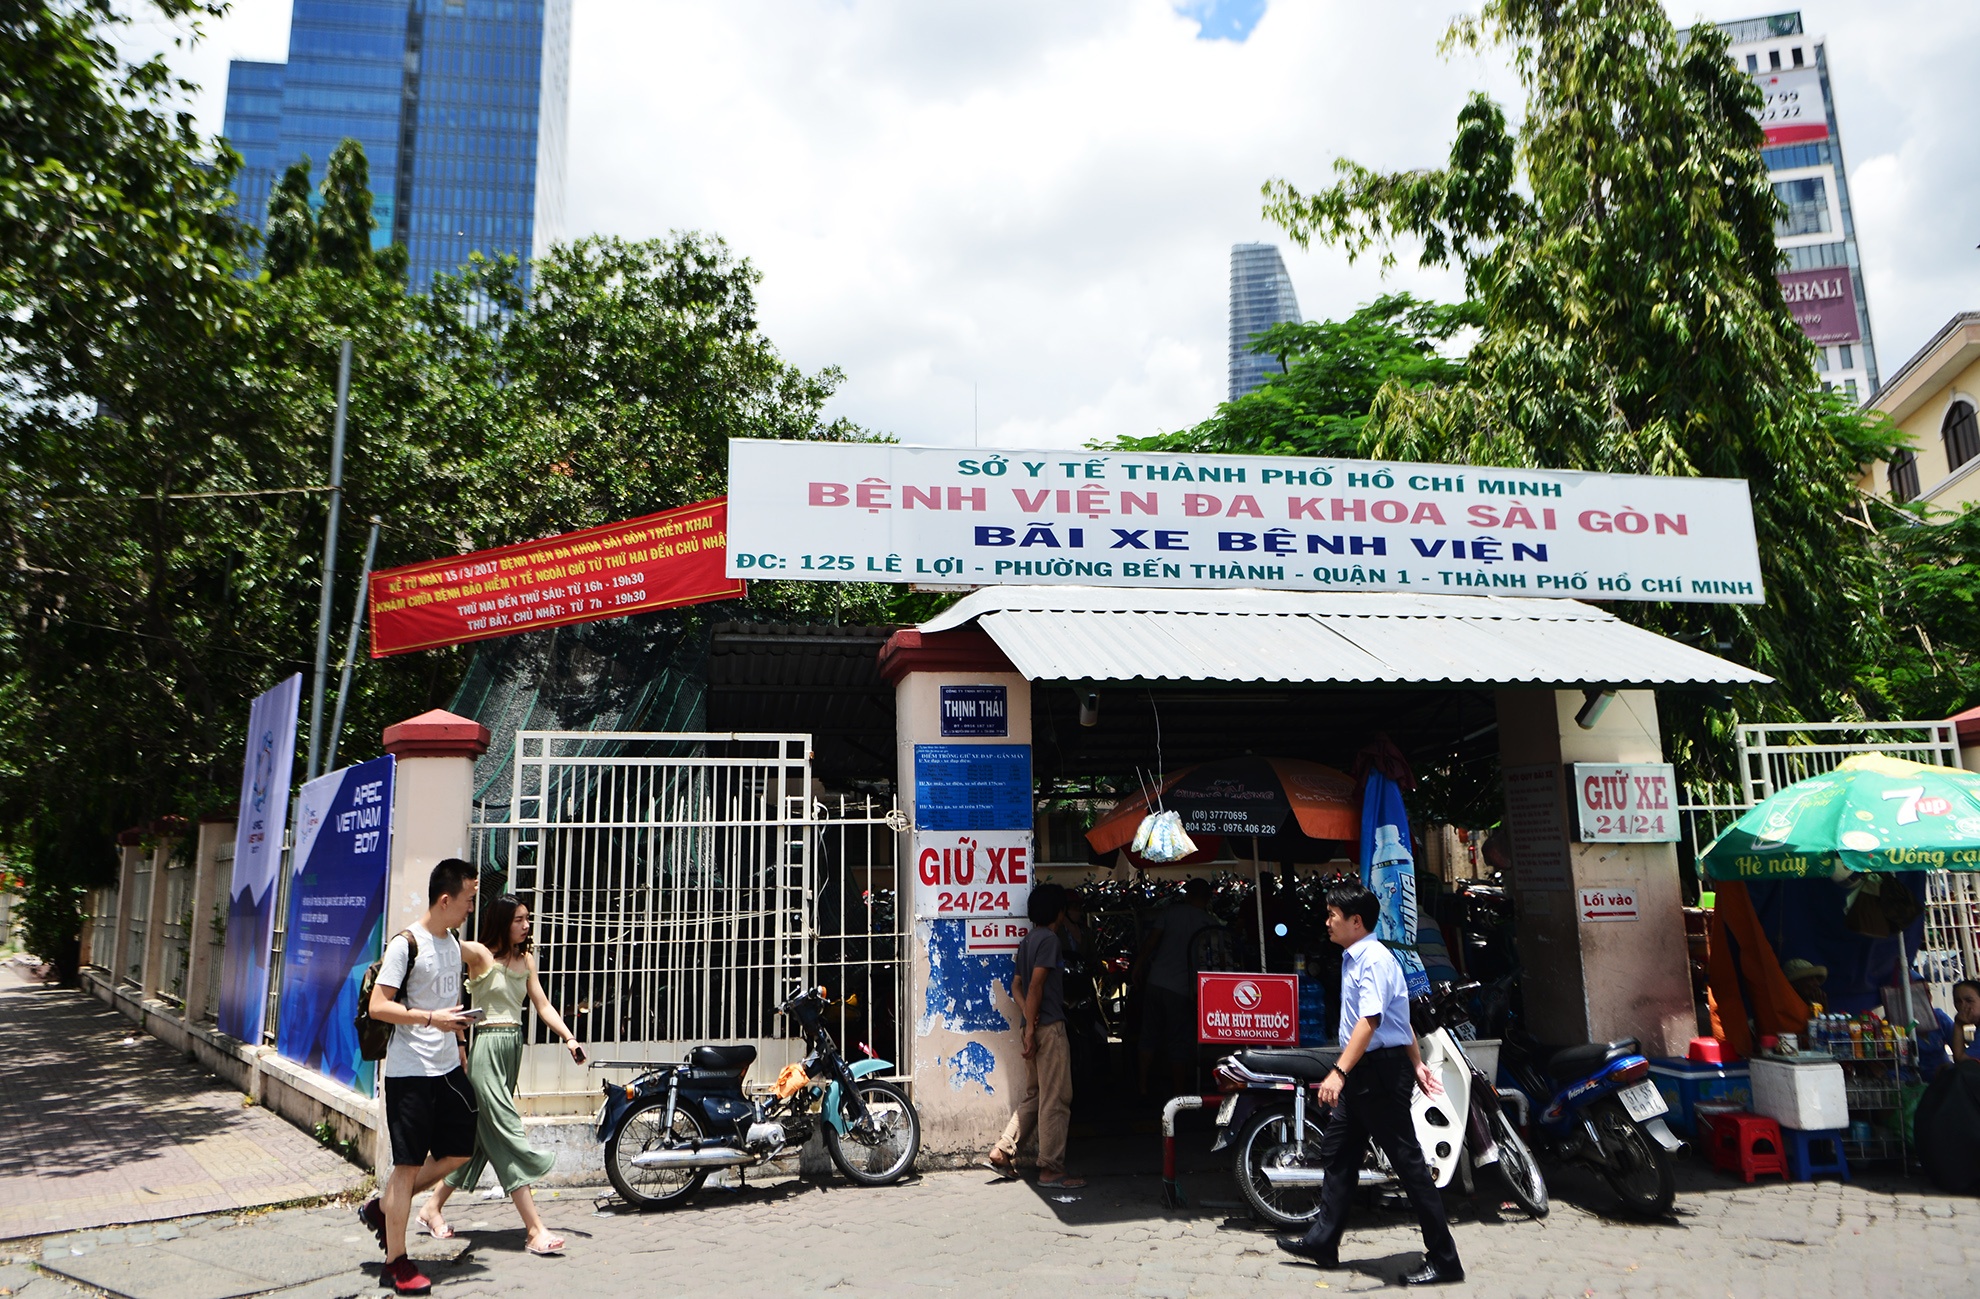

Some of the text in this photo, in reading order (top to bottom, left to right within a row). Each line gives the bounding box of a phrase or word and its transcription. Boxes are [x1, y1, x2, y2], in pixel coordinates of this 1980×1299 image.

[1782, 104, 1802, 119] 22
[1781, 278, 1844, 303] ERALI
[958, 454, 1562, 497] SỞ Y TẾ THÀNH PHỐ HỒ CHÍ MINH
[808, 478, 1688, 536] BỆNH VIỆN ĐA KHOA SÀI GÒN
[418, 572, 444, 587] NGÀY
[500, 554, 528, 571] BỆNH
[528, 550, 554, 564] VIỆN
[554, 548, 572, 560] ĐA
[571, 541, 602, 556] KHOA
[602, 534, 622, 550] SÀI
[623, 530, 648, 546] GÒN
[648, 519, 683, 540] TRIỂN
[685, 516, 713, 533] KHAI
[974, 522, 1548, 564] BÃI XE BỆNH VIỆN
[434, 587, 462, 602] BỆNH
[462, 581, 482, 596] BẢO
[484, 574, 510, 592] HIỂM
[510, 576, 518, 587] Y
[520, 568, 534, 585] TẾ
[535, 565, 567, 582] NGOÀI
[568, 561, 586, 576] GIỜ
[588, 557, 602, 572] TỪ
[604, 552, 626, 568] THỨ
[629, 550, 648, 564] HAI
[650, 542, 674, 560] ĐẾN
[676, 536, 700, 555] CHỦ
[702, 532, 728, 550] NHẬ
[736, 554, 786, 570] ĐC:
[800, 555, 855, 570] 125
[867, 554, 902, 573] LÊ
[916, 556, 964, 577] LỢI
[995, 558, 1112, 577] PHƯỜNG
[1123, 557, 1180, 578] BẾN
[1190, 561, 1284, 580] THÀNH
[1313, 564, 1386, 586] QUẬN
[1398, 570, 1410, 584] 1
[1438, 569, 1526, 588] THÀNH
[1536, 571, 1589, 590] PHỐ
[1598, 572, 1631, 592] HỒ
[1642, 576, 1682, 593] CHÍ
[1692, 580, 1753, 594] MINH
[457, 602, 478, 616] THỨ
[479, 600, 496, 612] HAI
[498, 594, 518, 608] ĐẾN
[520, 590, 540, 604] THỨ
[542, 586, 566, 600] SÁU:
[566, 582, 582, 596] TỪ
[584, 580, 603, 593] 16h
[612, 572, 645, 588] 19h30
[466, 618, 487, 630] THỨ
[513, 607, 533, 622] CHỦ
[536, 604, 566, 618] NHẬT:
[570, 598, 584, 612] TỪ
[590, 598, 602, 610] 7h
[614, 590, 646, 605] 19h30
[944, 696, 1002, 721] THỊNH THÁI
[352, 781, 383, 806] APEC
[1584, 769, 1668, 810] GIỮ XE
[1185, 822, 1200, 831] 804
[1202, 822, 1216, 832] 325
[1223, 823, 1259, 833] 0976.406
[1261, 825, 1276, 834] 226
[1192, 810, 1248, 821] (08) 37770695
[1596, 815, 1666, 834] 24/24
[354, 831, 380, 854] 2017
[918, 836, 1028, 886] GIỮ XE
[1734, 852, 1810, 877] Hè này
[1884, 845, 1948, 868] Uống
[938, 891, 1010, 913] 24/24
[1584, 892, 1632, 906] Lối vào
[971, 923, 1028, 938] Lối Ra
[1206, 1010, 1290, 1028] CẤM HÚT THUỐC
[1234, 1030, 1279, 1038] SMOKING
